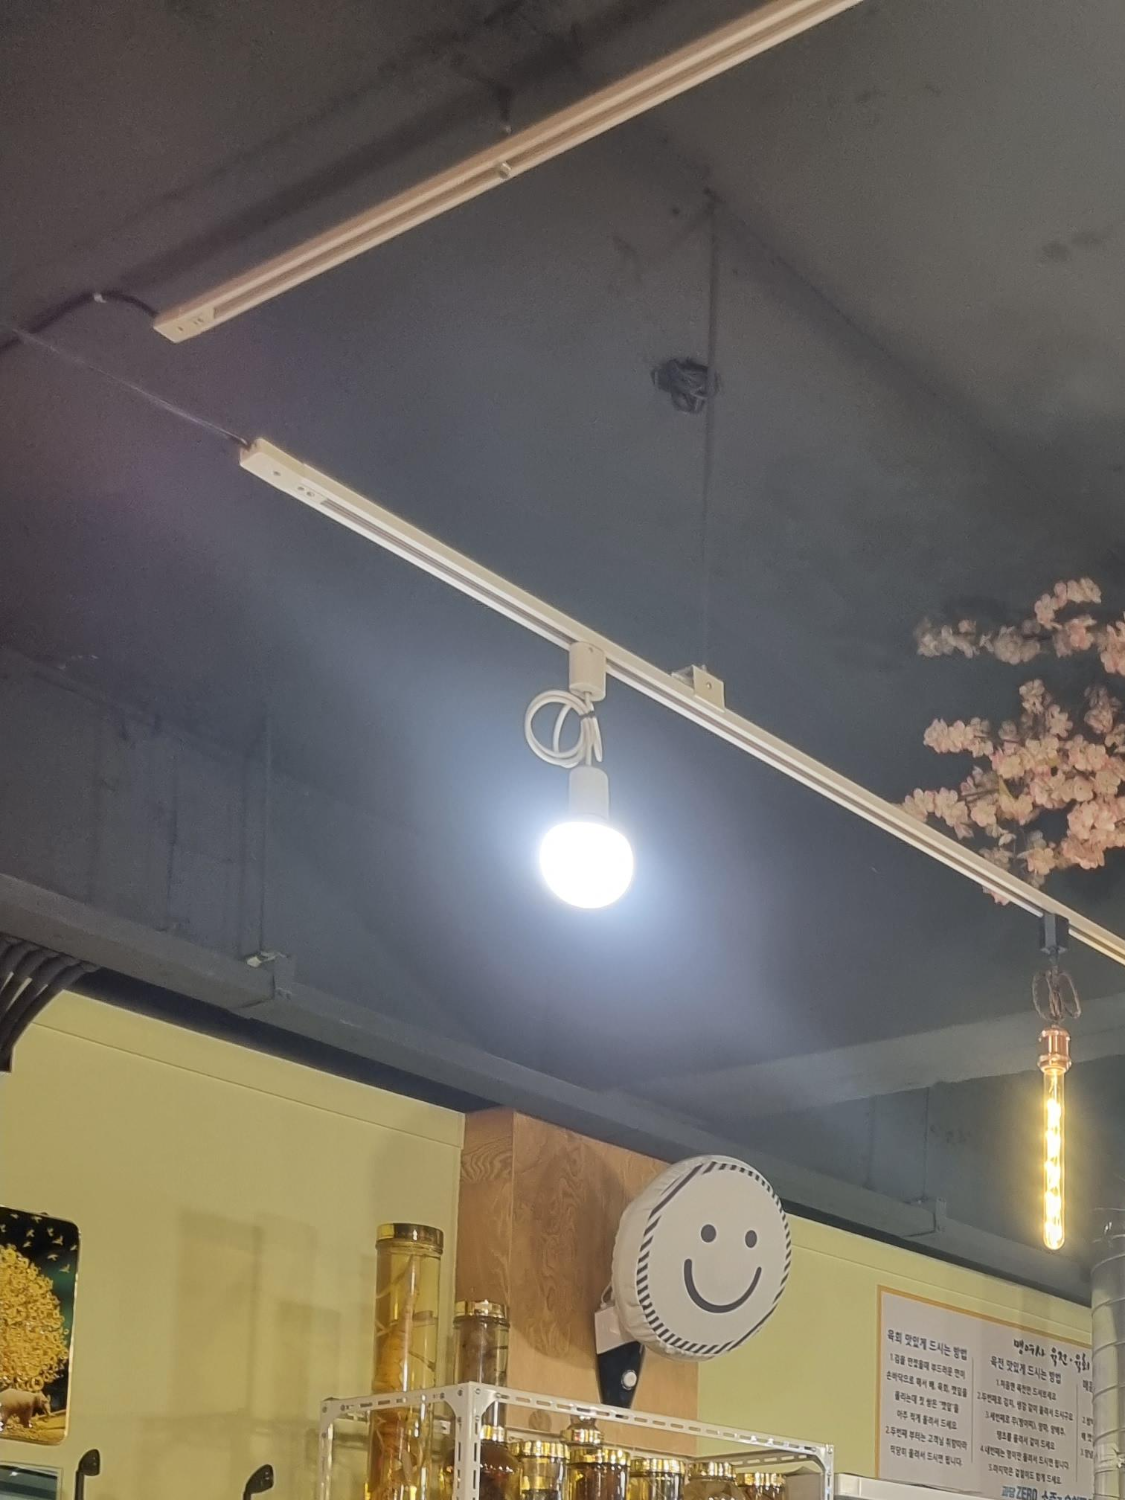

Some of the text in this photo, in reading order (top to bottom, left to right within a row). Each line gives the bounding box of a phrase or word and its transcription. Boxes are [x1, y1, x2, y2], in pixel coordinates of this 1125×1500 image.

[887, 1329, 967, 1360] 육회 맛있게 드시는 방법
[886, 1370, 914, 1384] 손바닥으로
[990, 1356, 1061, 1384] 육전 맛있게 드시는 방법
[940, 1419, 957, 1430] 드세요
